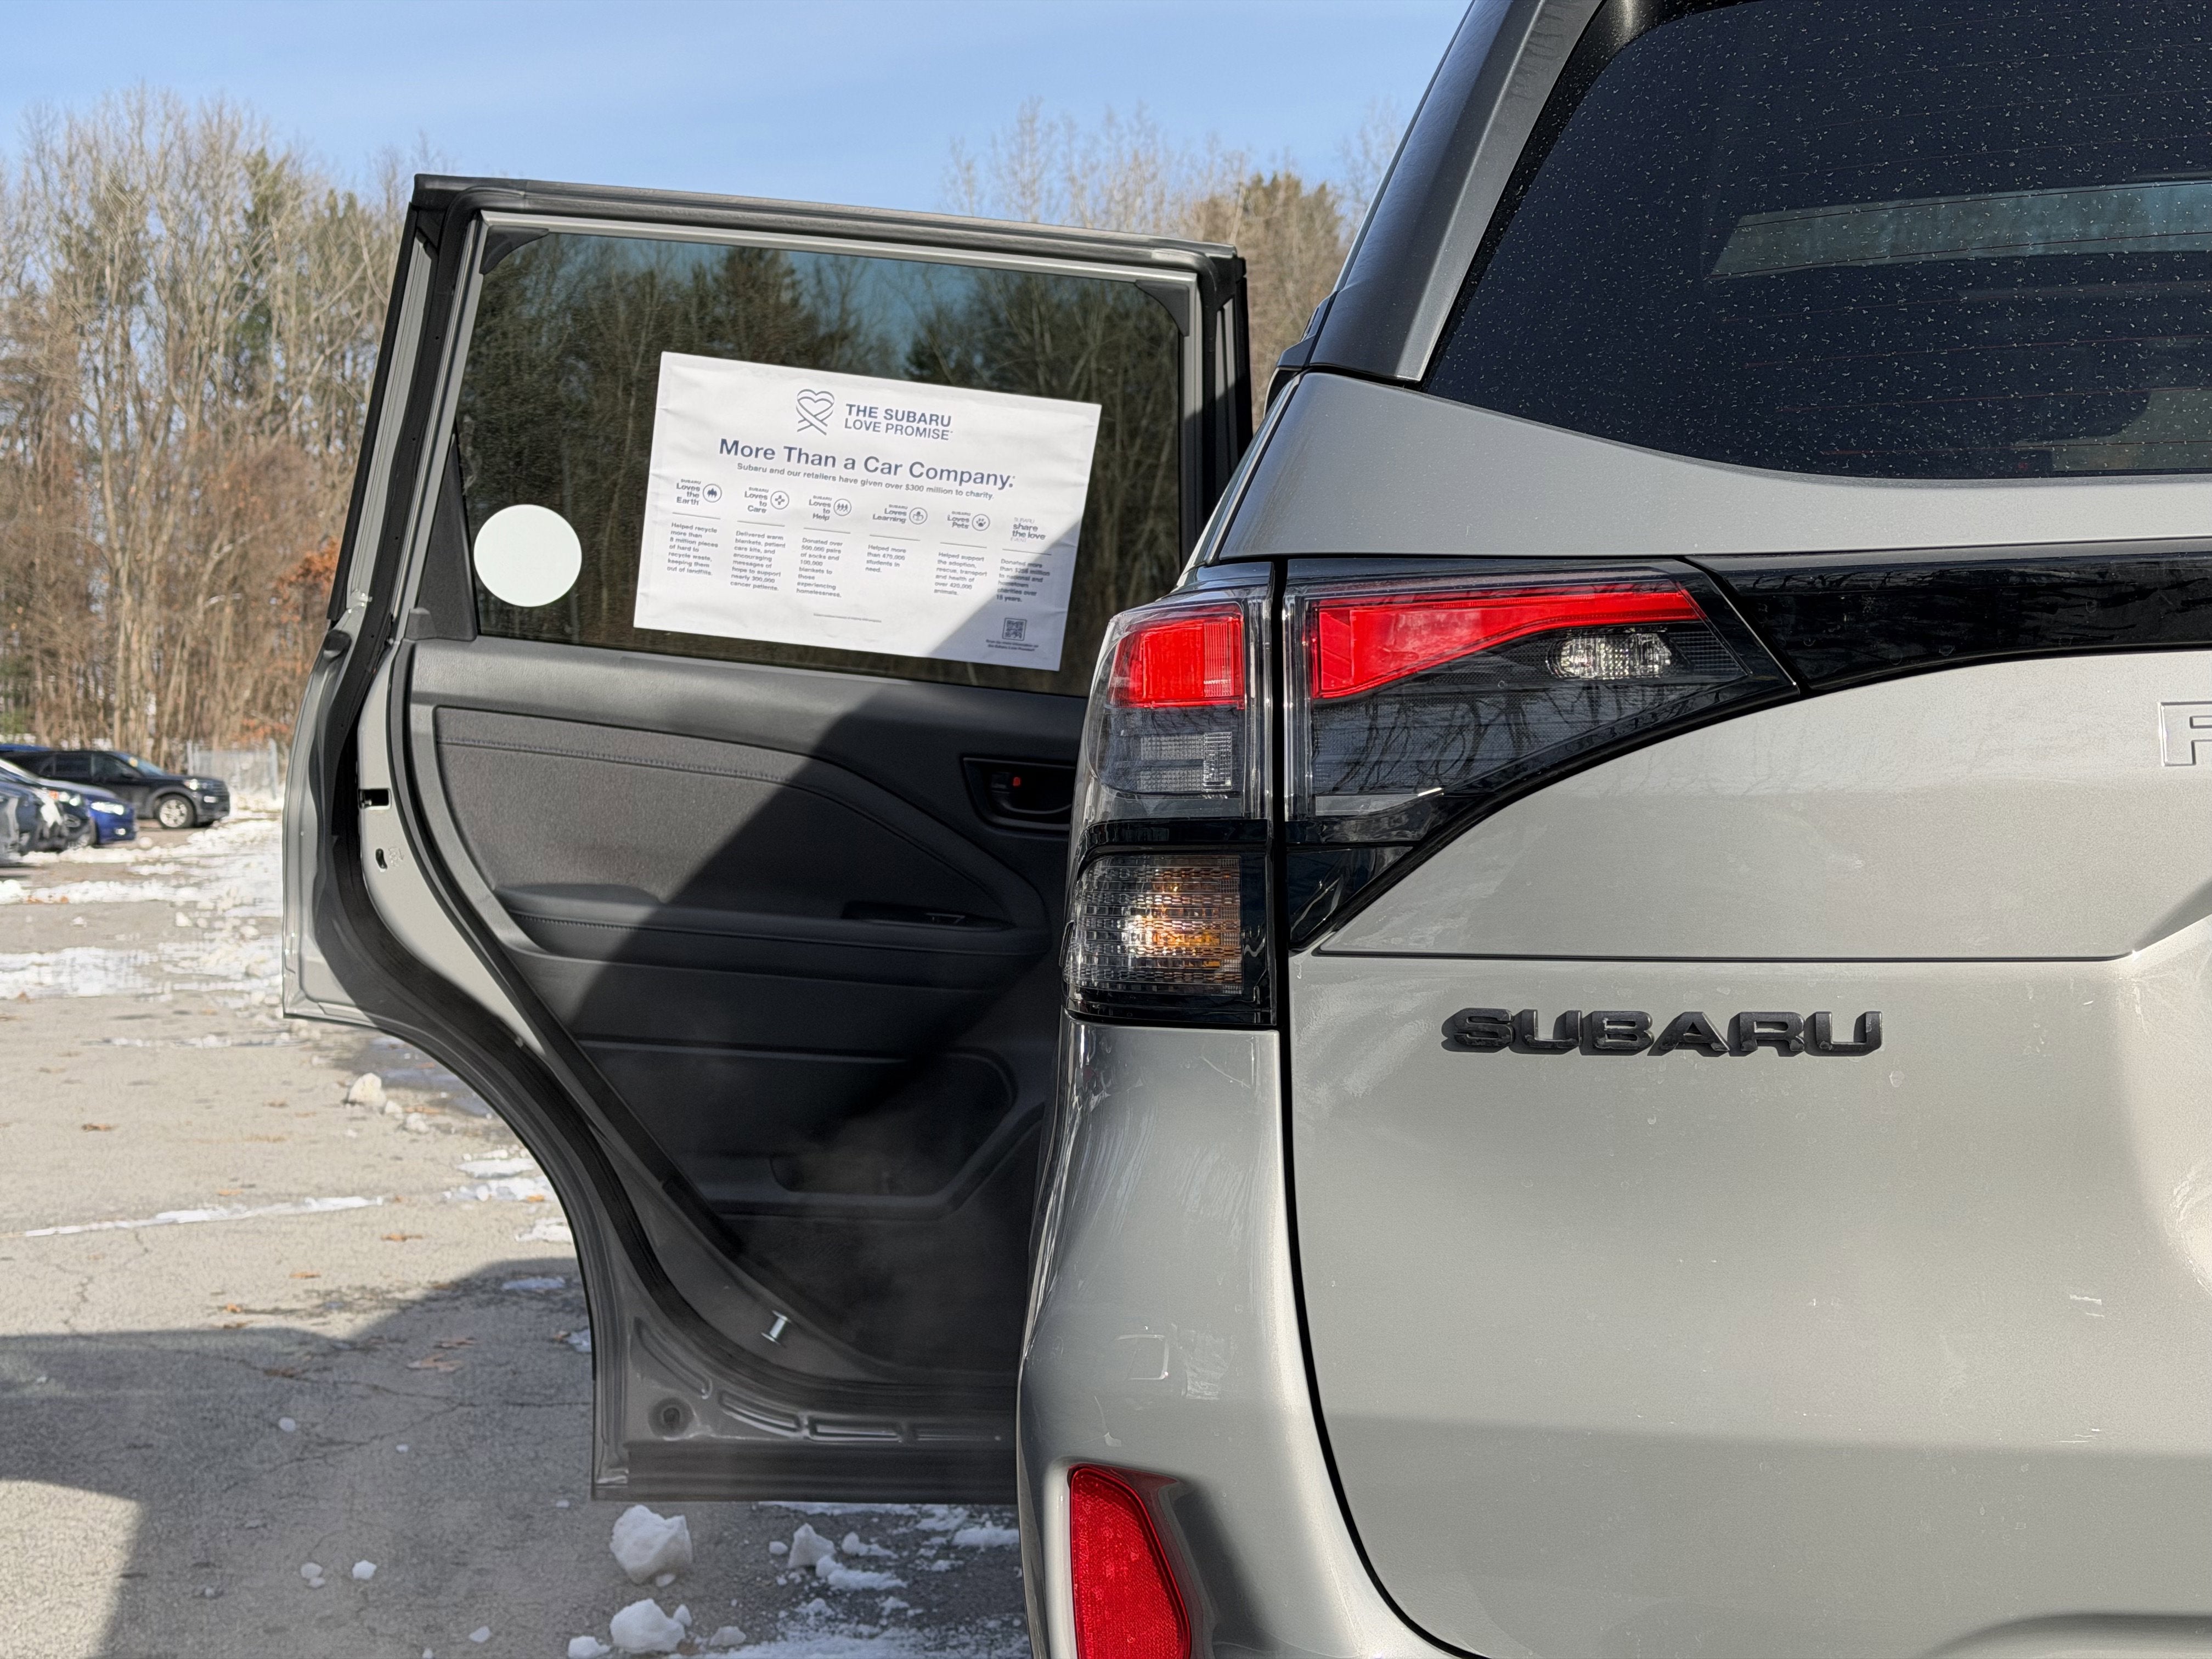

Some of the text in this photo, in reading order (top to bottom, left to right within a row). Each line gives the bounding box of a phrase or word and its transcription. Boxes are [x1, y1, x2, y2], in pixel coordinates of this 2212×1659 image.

[845, 403, 952, 427] THE SUBARU
[844, 417, 882, 433] LOVE
[719, 438, 776, 460] More
[783, 445, 836, 468] Than
[843, 458, 856, 471] a
[864, 456, 903, 476] Car
[737, 462, 768, 473] Subaru
[803, 472, 837, 482] retailers
[838, 475, 859, 485] have
[860, 478, 883, 488] given
[884, 482, 904, 490] over
[904, 483, 924, 492] $300
[926, 486, 953, 495] million
[965, 490, 995, 501] charity.
[676, 482, 701, 492] Loves
[686, 490, 700, 499] the
[744, 490, 768, 500] Loves
[676, 496, 699, 506] Earth
[808, 499, 831, 508] Loves
[747, 505, 767, 514] Care
[884, 507, 907, 517] Loves
[812, 512, 831, 522] Help
[872, 513, 907, 524] Learning
[947, 514, 970, 523] Loves
[951, 521, 970, 529] Pets
[1013, 522, 1039, 532] share
[1012, 529, 1047, 540] the love
[1444, 1007, 1884, 1056] SUBARU
